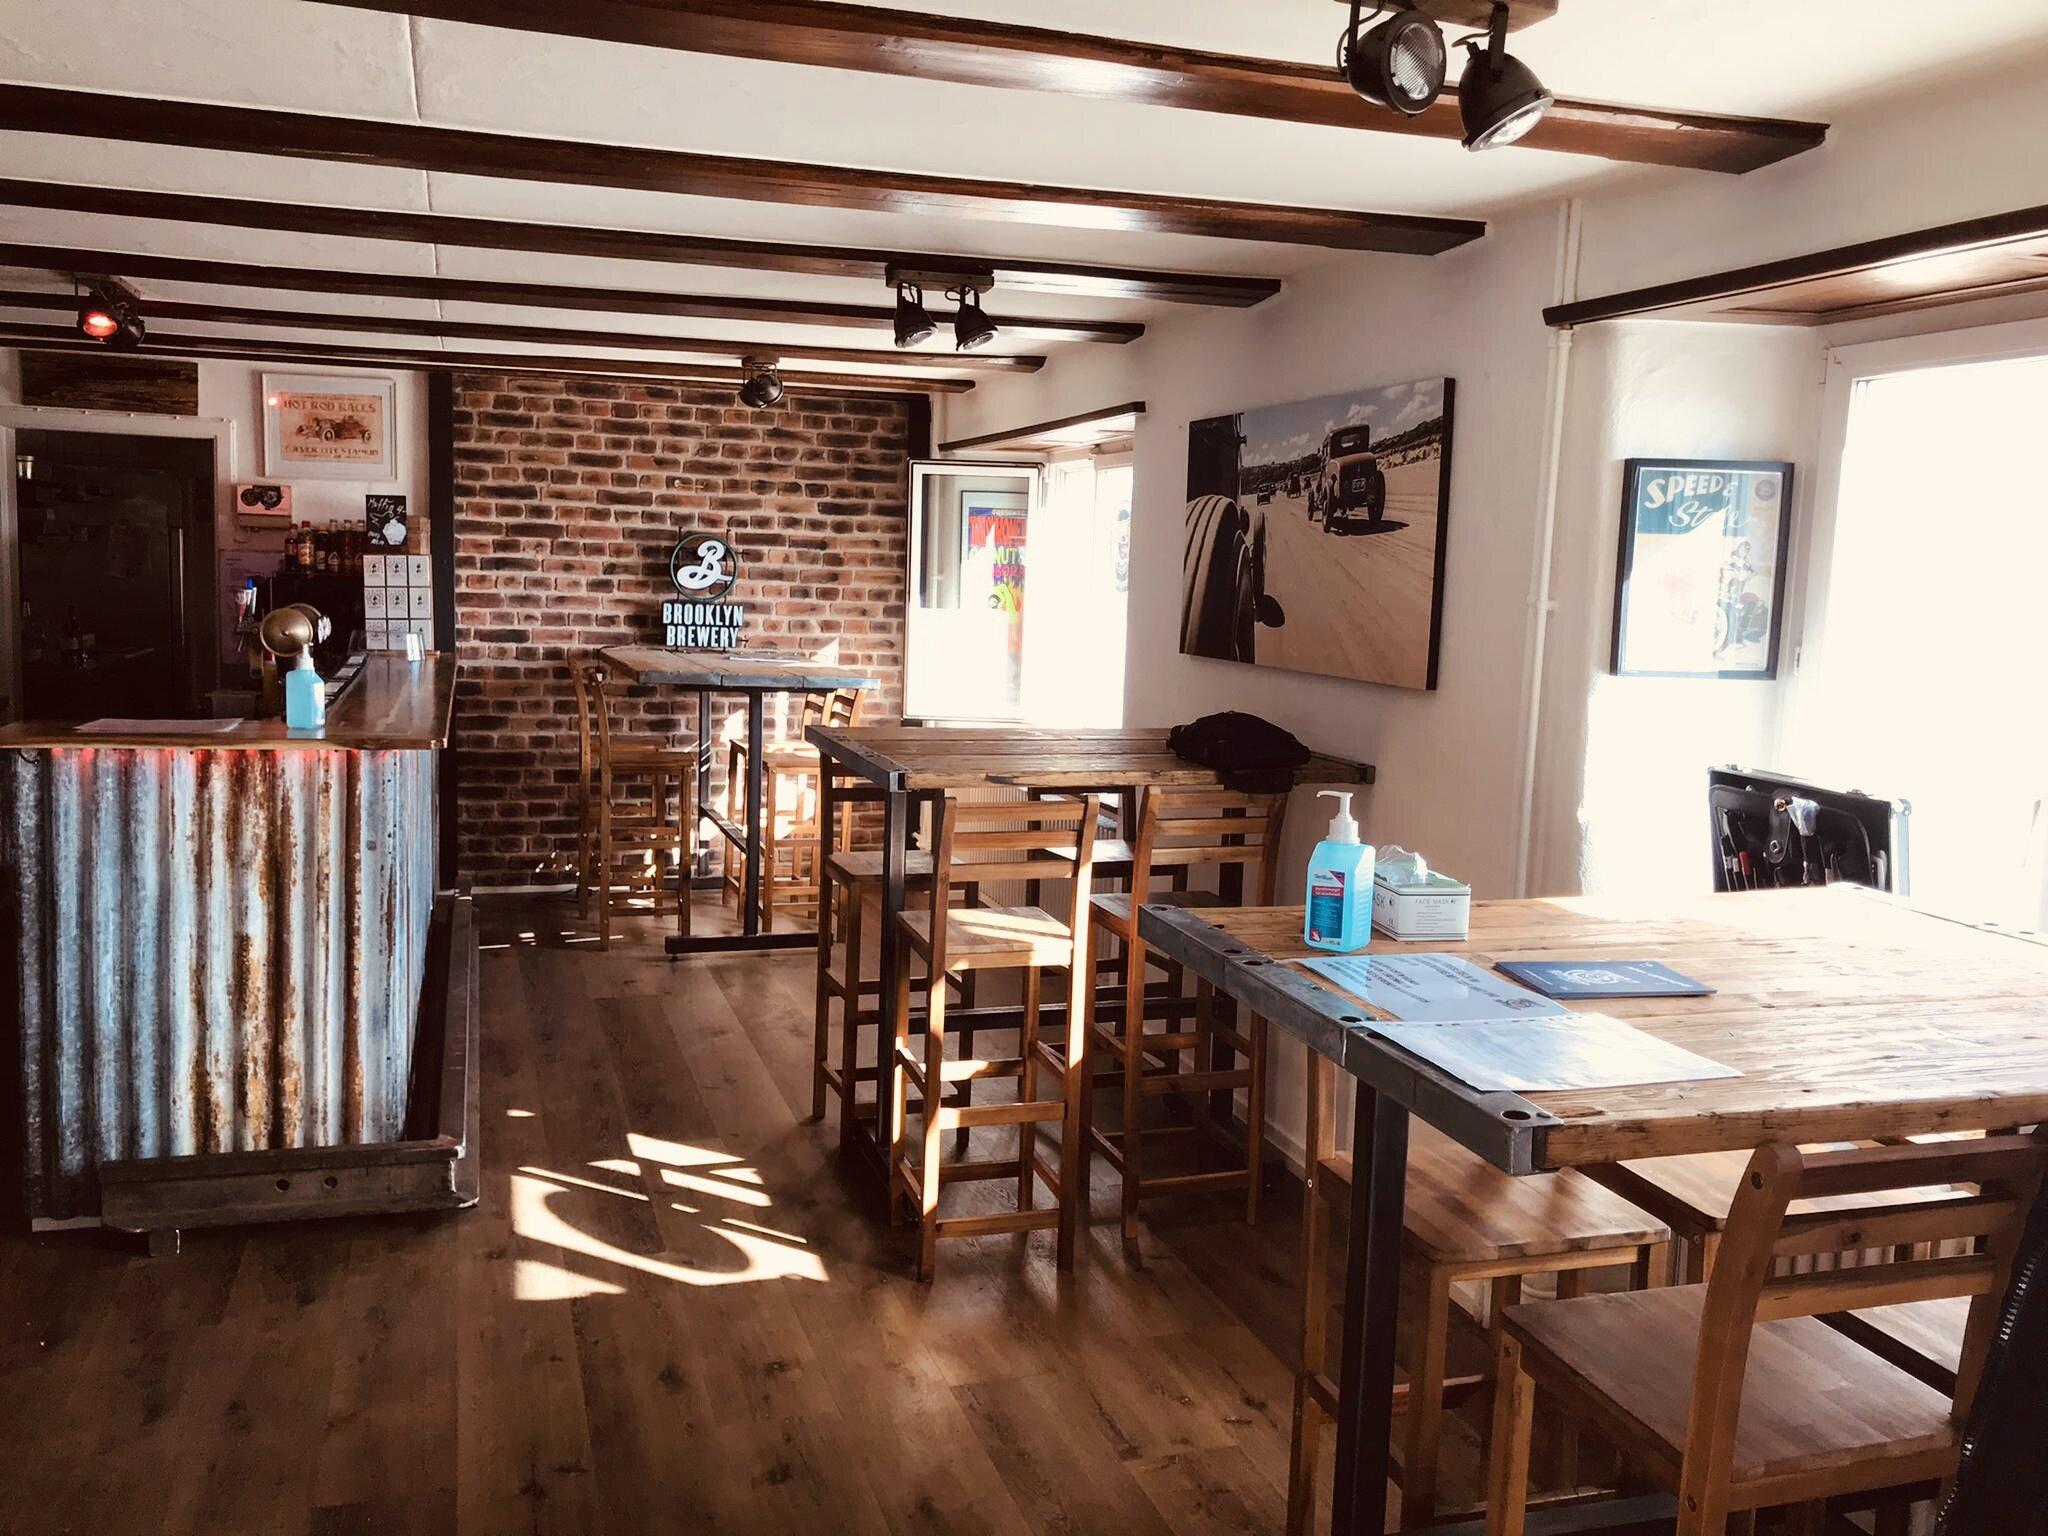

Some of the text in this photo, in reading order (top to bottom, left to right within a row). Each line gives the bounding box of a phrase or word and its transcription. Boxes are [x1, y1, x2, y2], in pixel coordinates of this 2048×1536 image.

[284, 399, 376, 413] HOT ROD RACES
[1644, 474, 1724, 509] SPEED
[662, 602, 744, 627] BROOKLYN
[666, 625, 739, 648] BREWERY
[1415, 897, 1450, 905] FACE MASK
